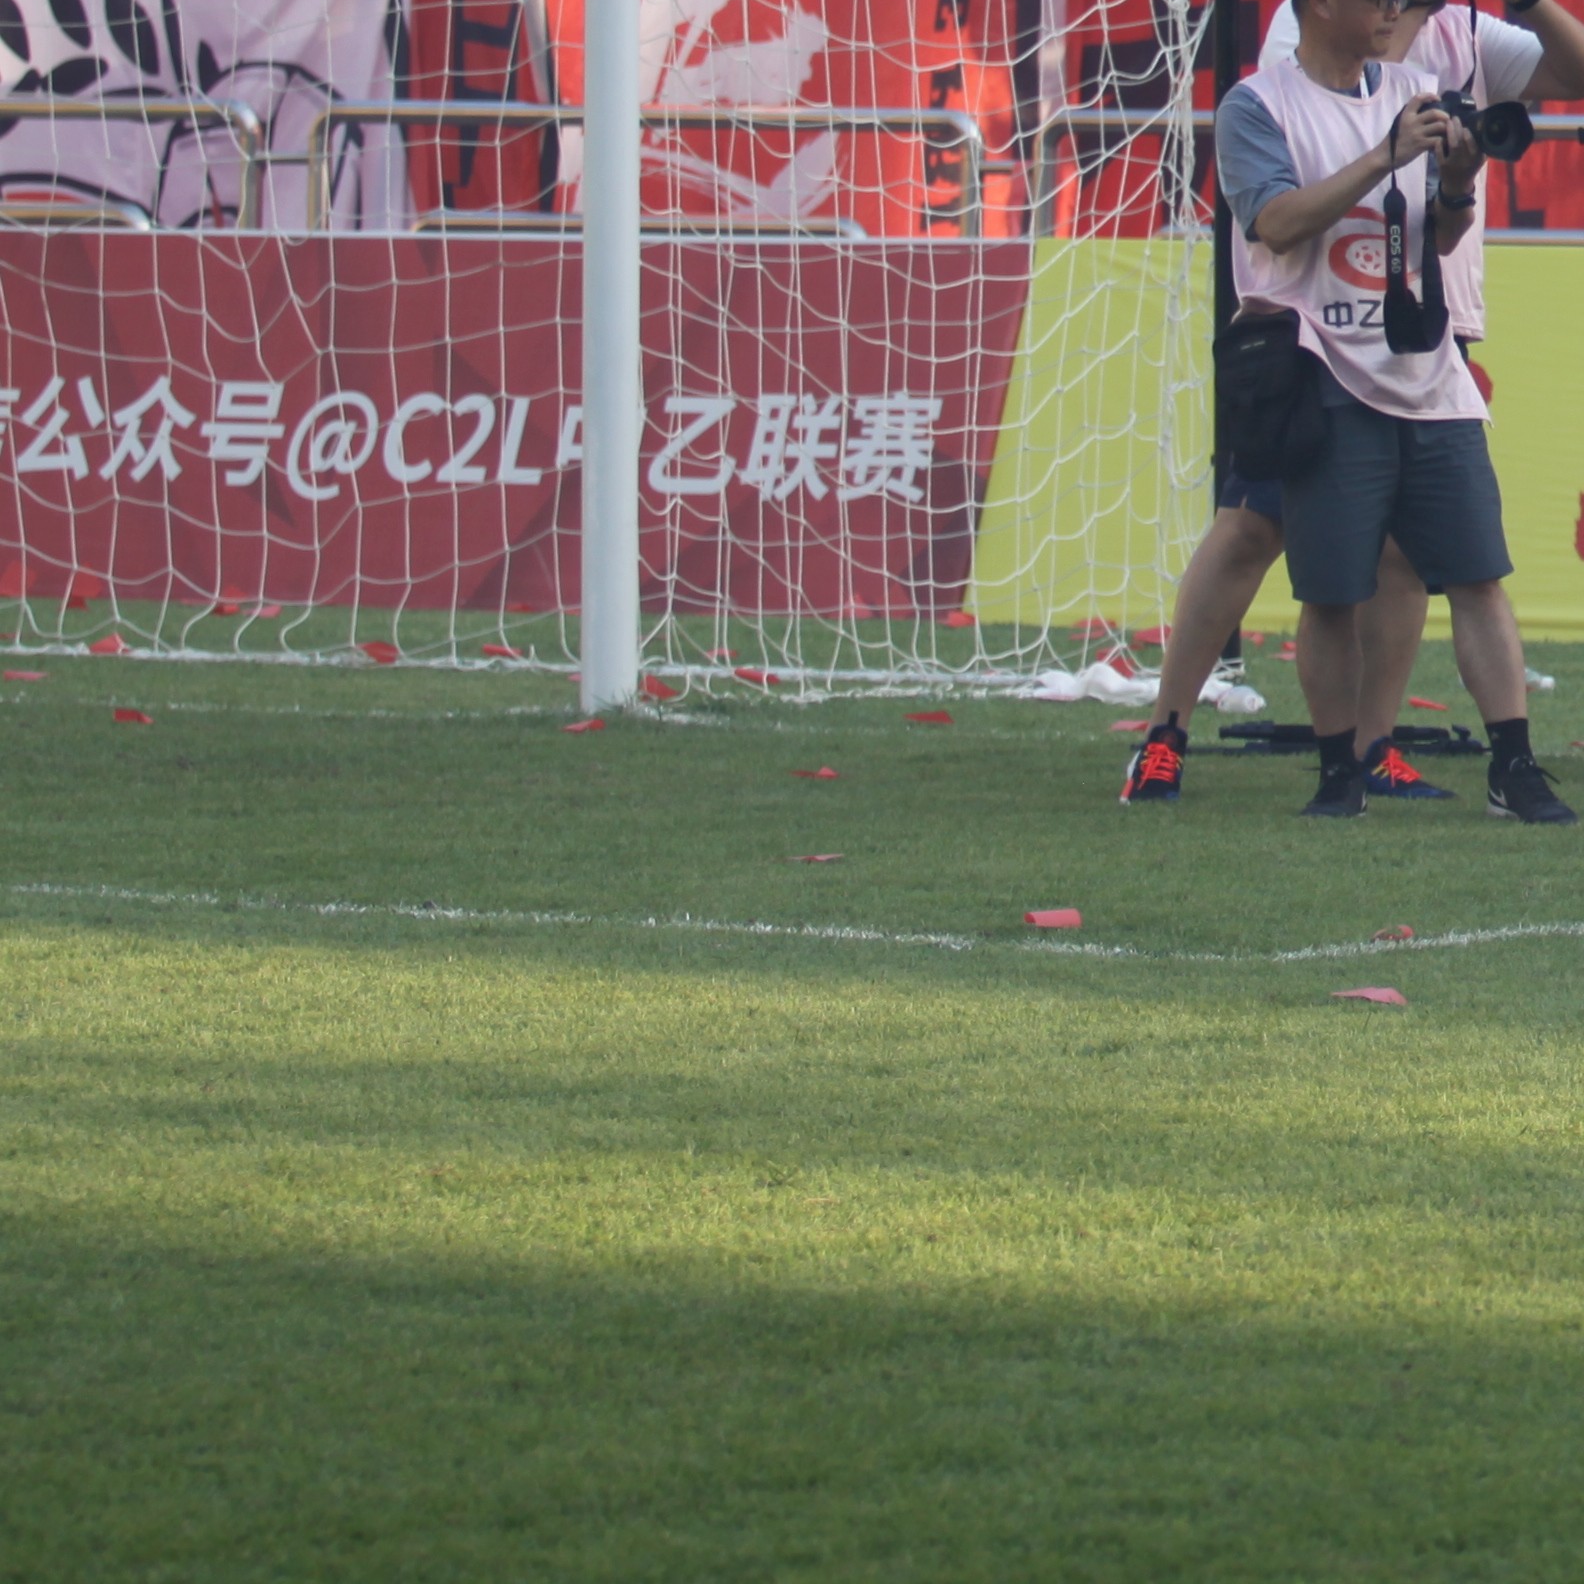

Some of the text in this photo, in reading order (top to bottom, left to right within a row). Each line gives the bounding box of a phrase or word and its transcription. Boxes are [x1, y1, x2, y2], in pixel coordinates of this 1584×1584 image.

[1389, 224, 1402, 255] EOS
[0, 375, 944, 503] 公众号@C2L乙联赛
